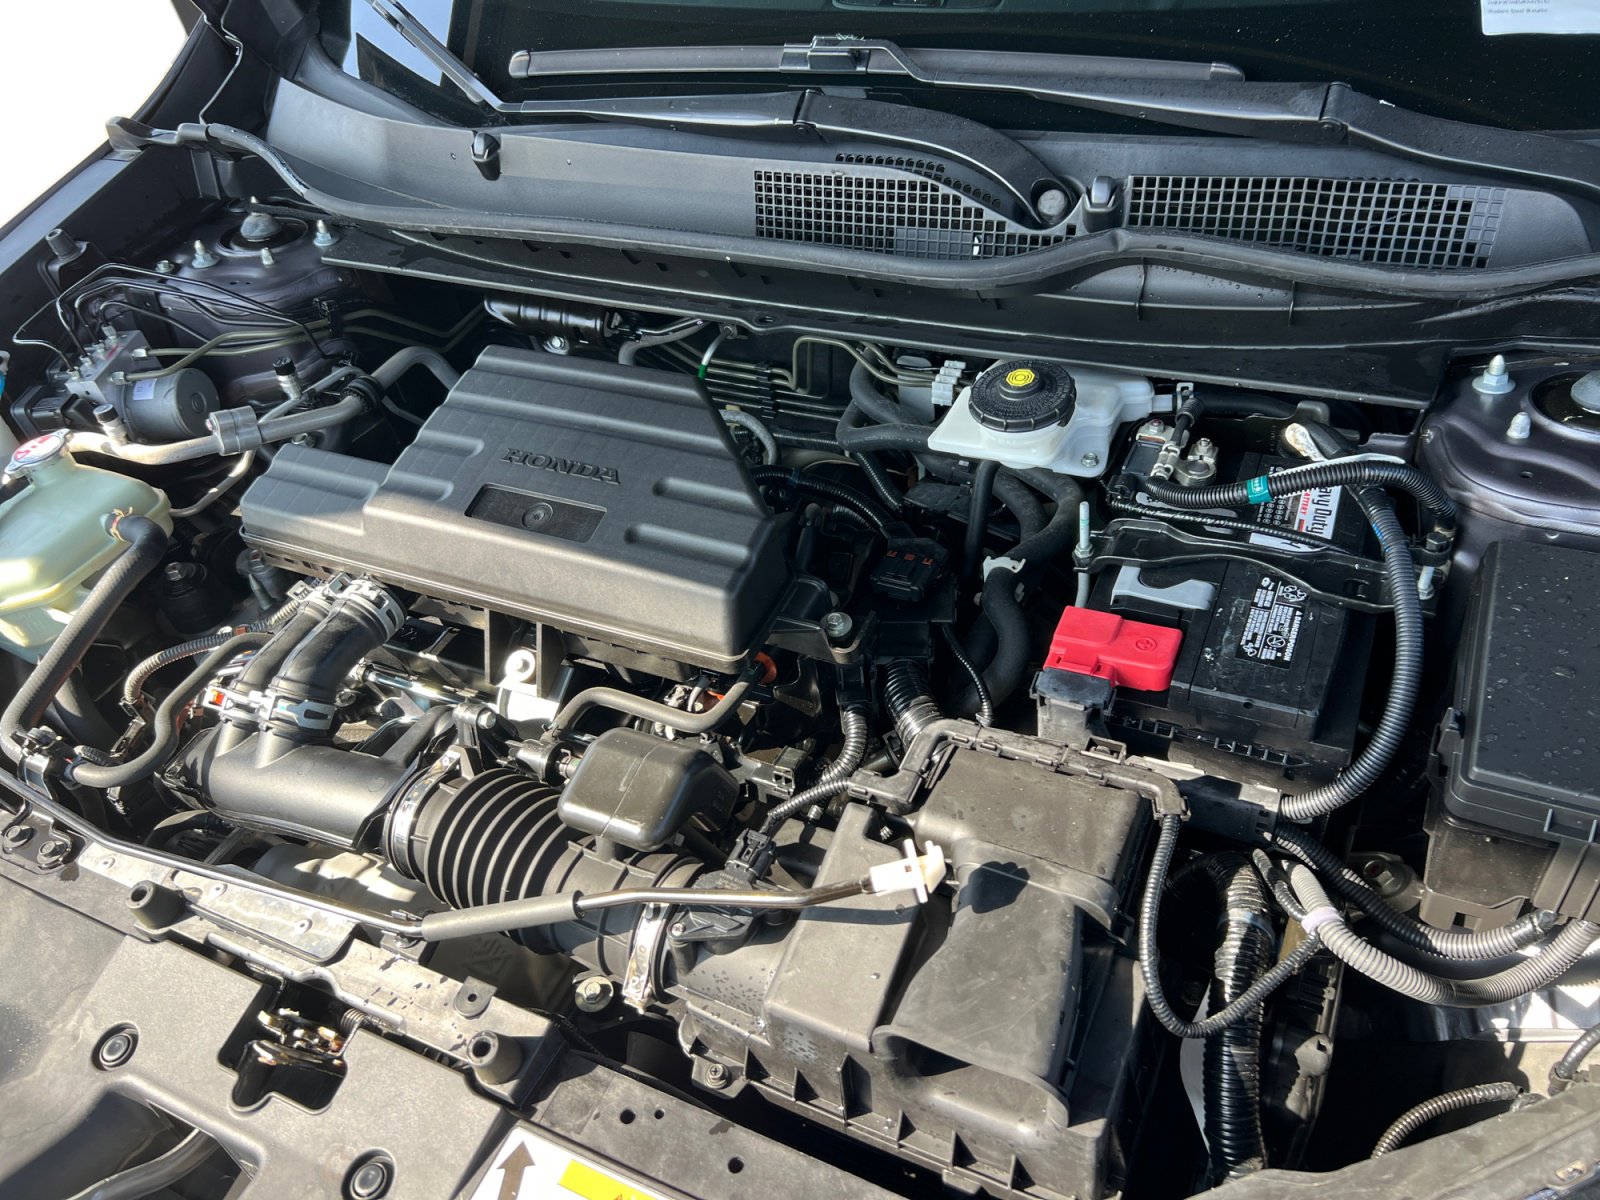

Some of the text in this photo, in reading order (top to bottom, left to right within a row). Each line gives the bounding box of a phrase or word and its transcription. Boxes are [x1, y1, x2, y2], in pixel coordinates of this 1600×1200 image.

[501, 448, 620, 485] HONDA
[1300, 492, 1311, 516] ATTERY
[1305, 487, 1332, 534] avy Duty
